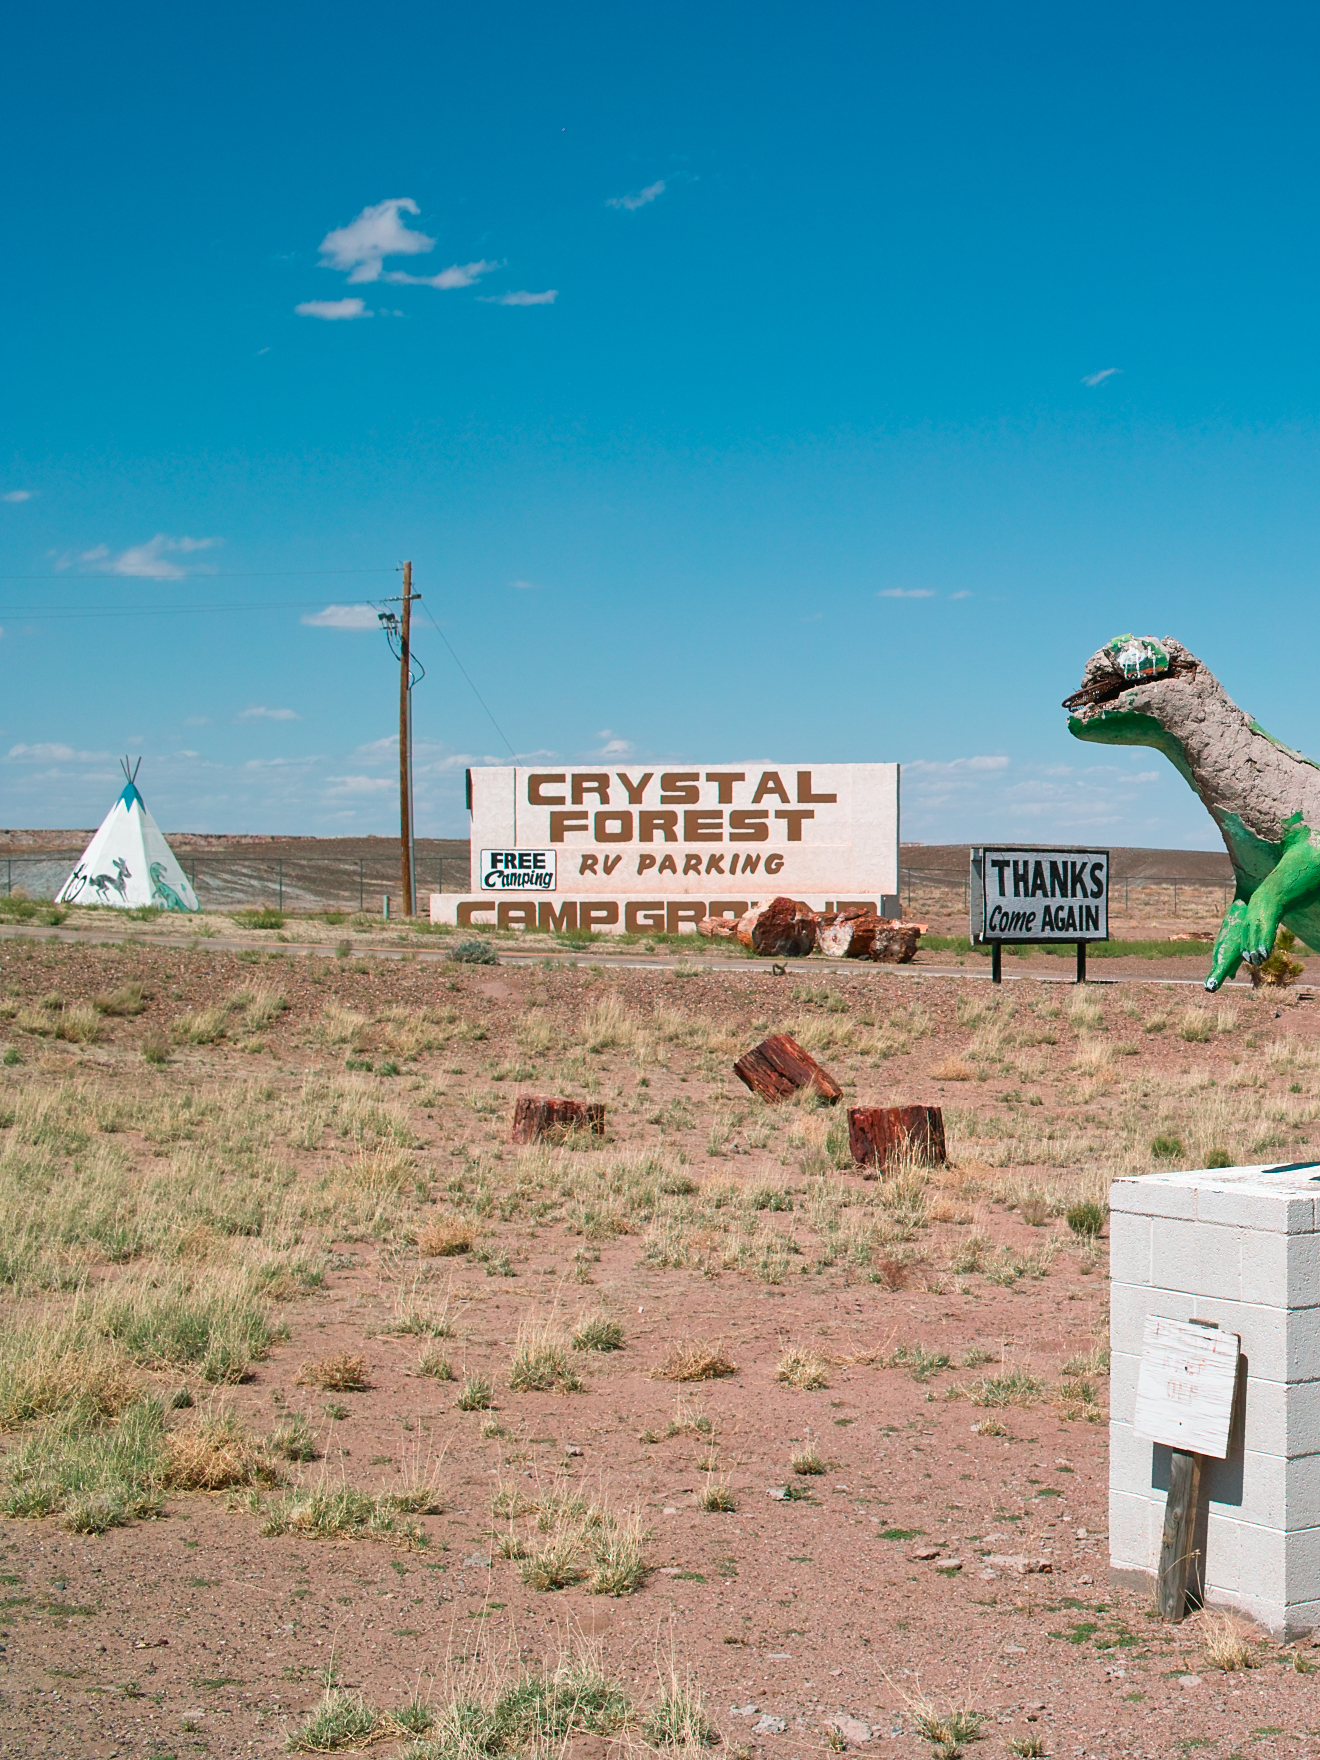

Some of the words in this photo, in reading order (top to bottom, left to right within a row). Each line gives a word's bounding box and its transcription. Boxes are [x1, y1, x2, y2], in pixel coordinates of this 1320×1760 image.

[528, 770, 837, 806] CRYSTAL
[549, 809, 815, 843] FOREST
[490, 852, 546, 869] FREE
[579, 853, 622, 876] RV
[637, 852, 785, 876] PARKING
[484, 870, 554, 888] Camping
[991, 859, 1104, 899] THANKS
[456, 900, 878, 934] CAMPGRO
[988, 904, 1036, 932] Come
[1041, 904, 1099, 933] AGAIN
